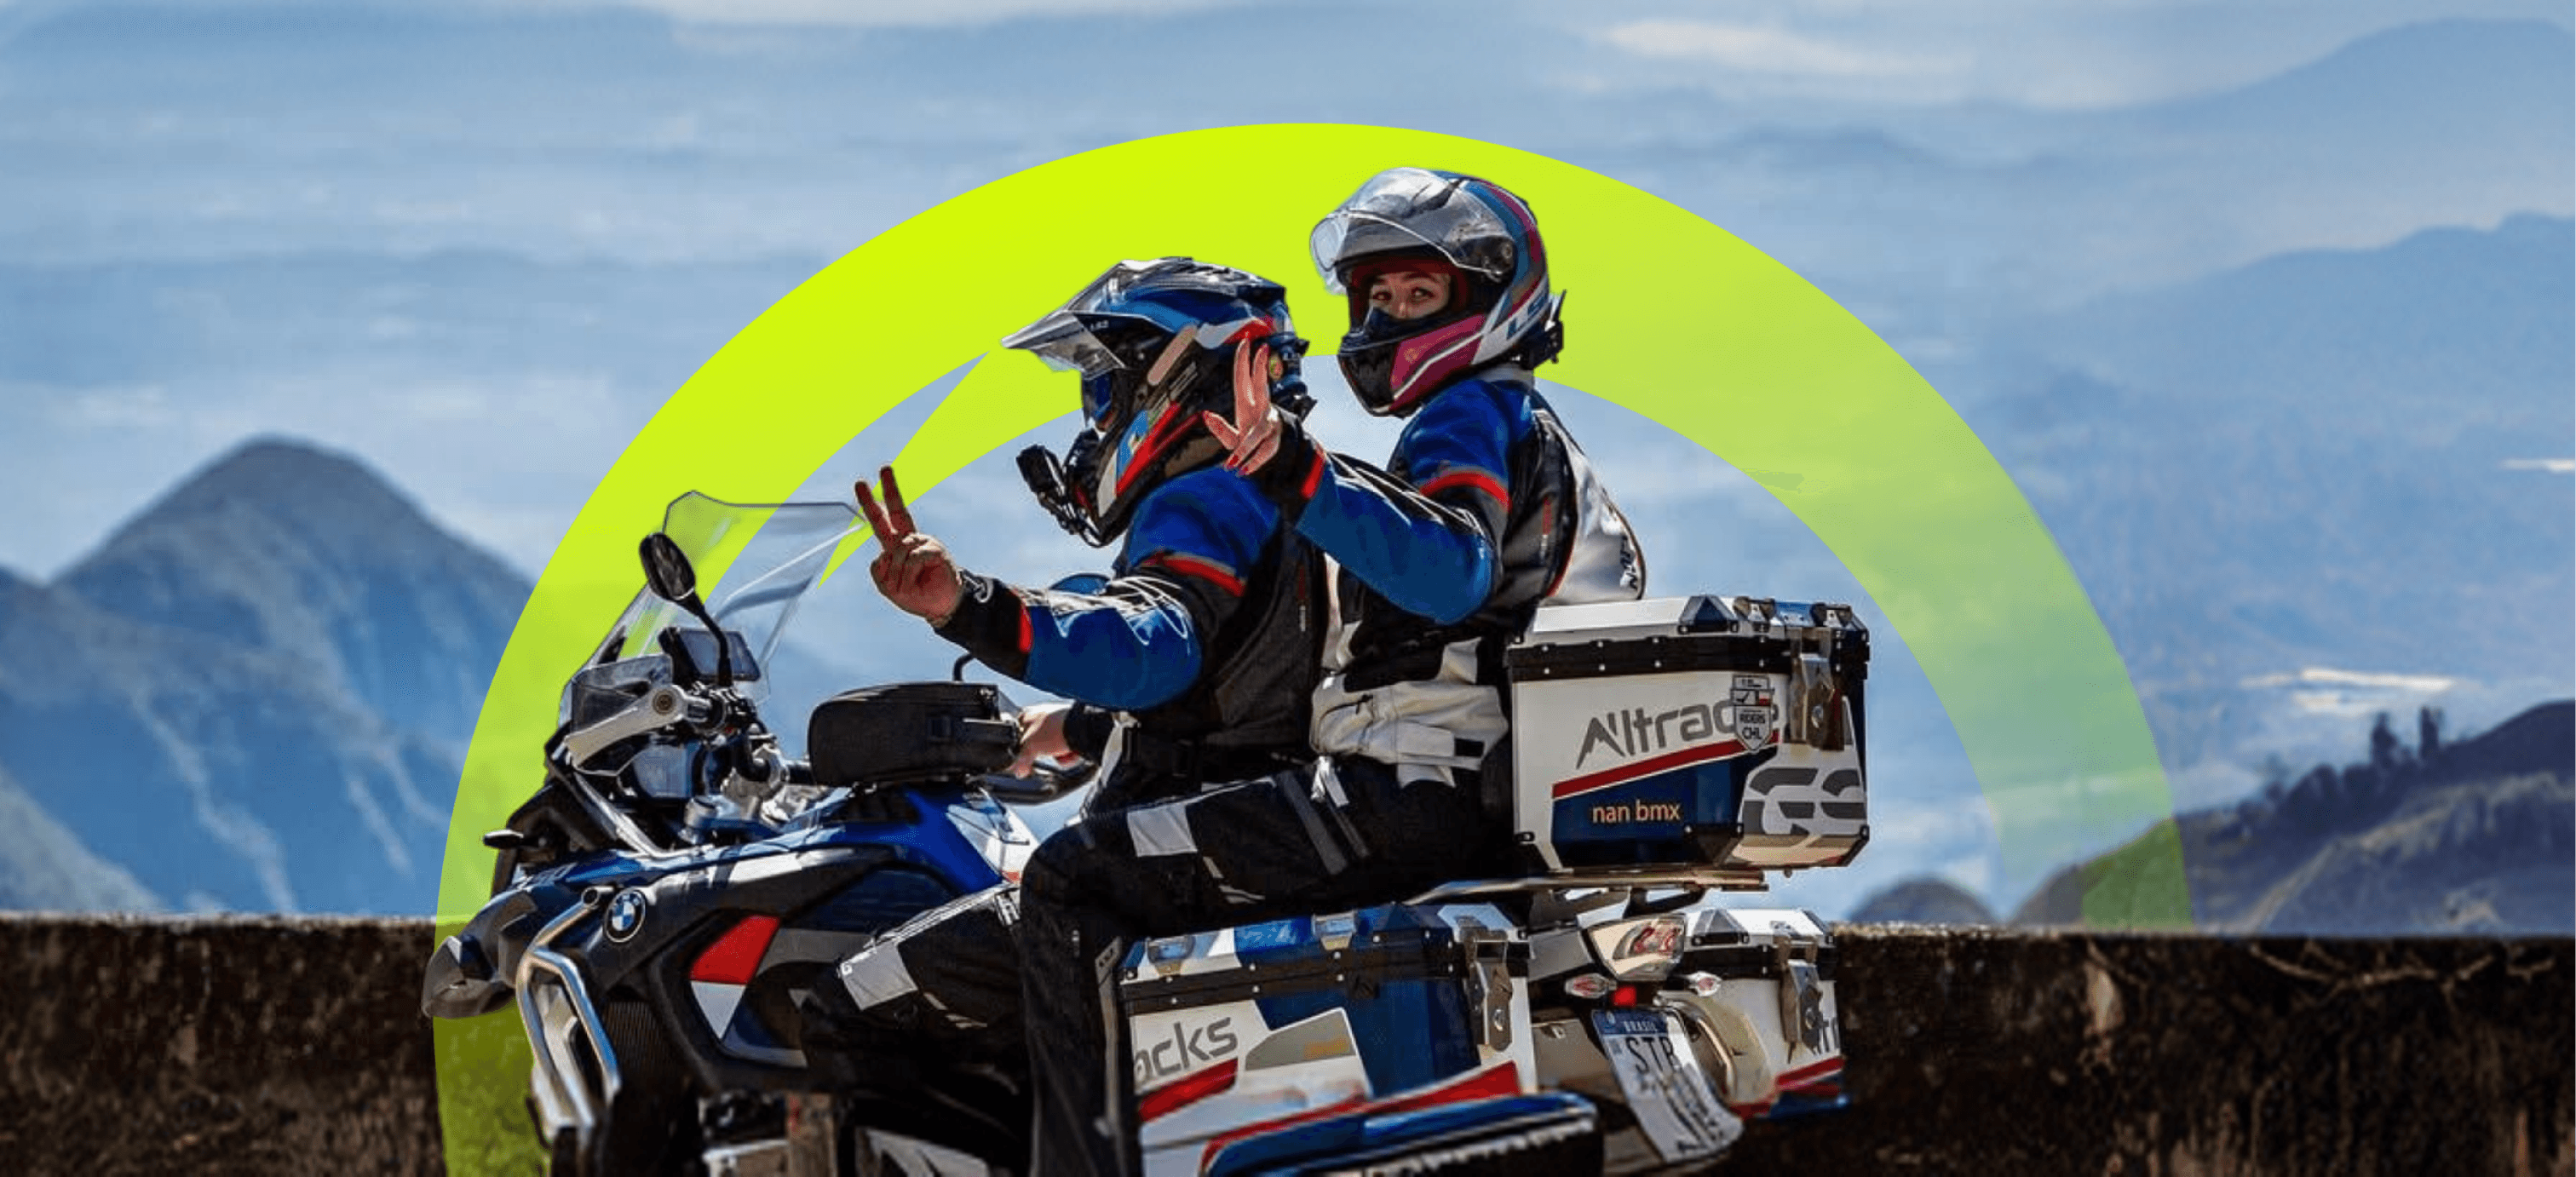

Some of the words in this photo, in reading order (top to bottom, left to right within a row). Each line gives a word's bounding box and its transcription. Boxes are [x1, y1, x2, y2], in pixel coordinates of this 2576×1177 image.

[1576, 699, 1780, 769] Alltrac
[1592, 806, 1630, 824] nan
[1636, 799, 1681, 821] bmx
